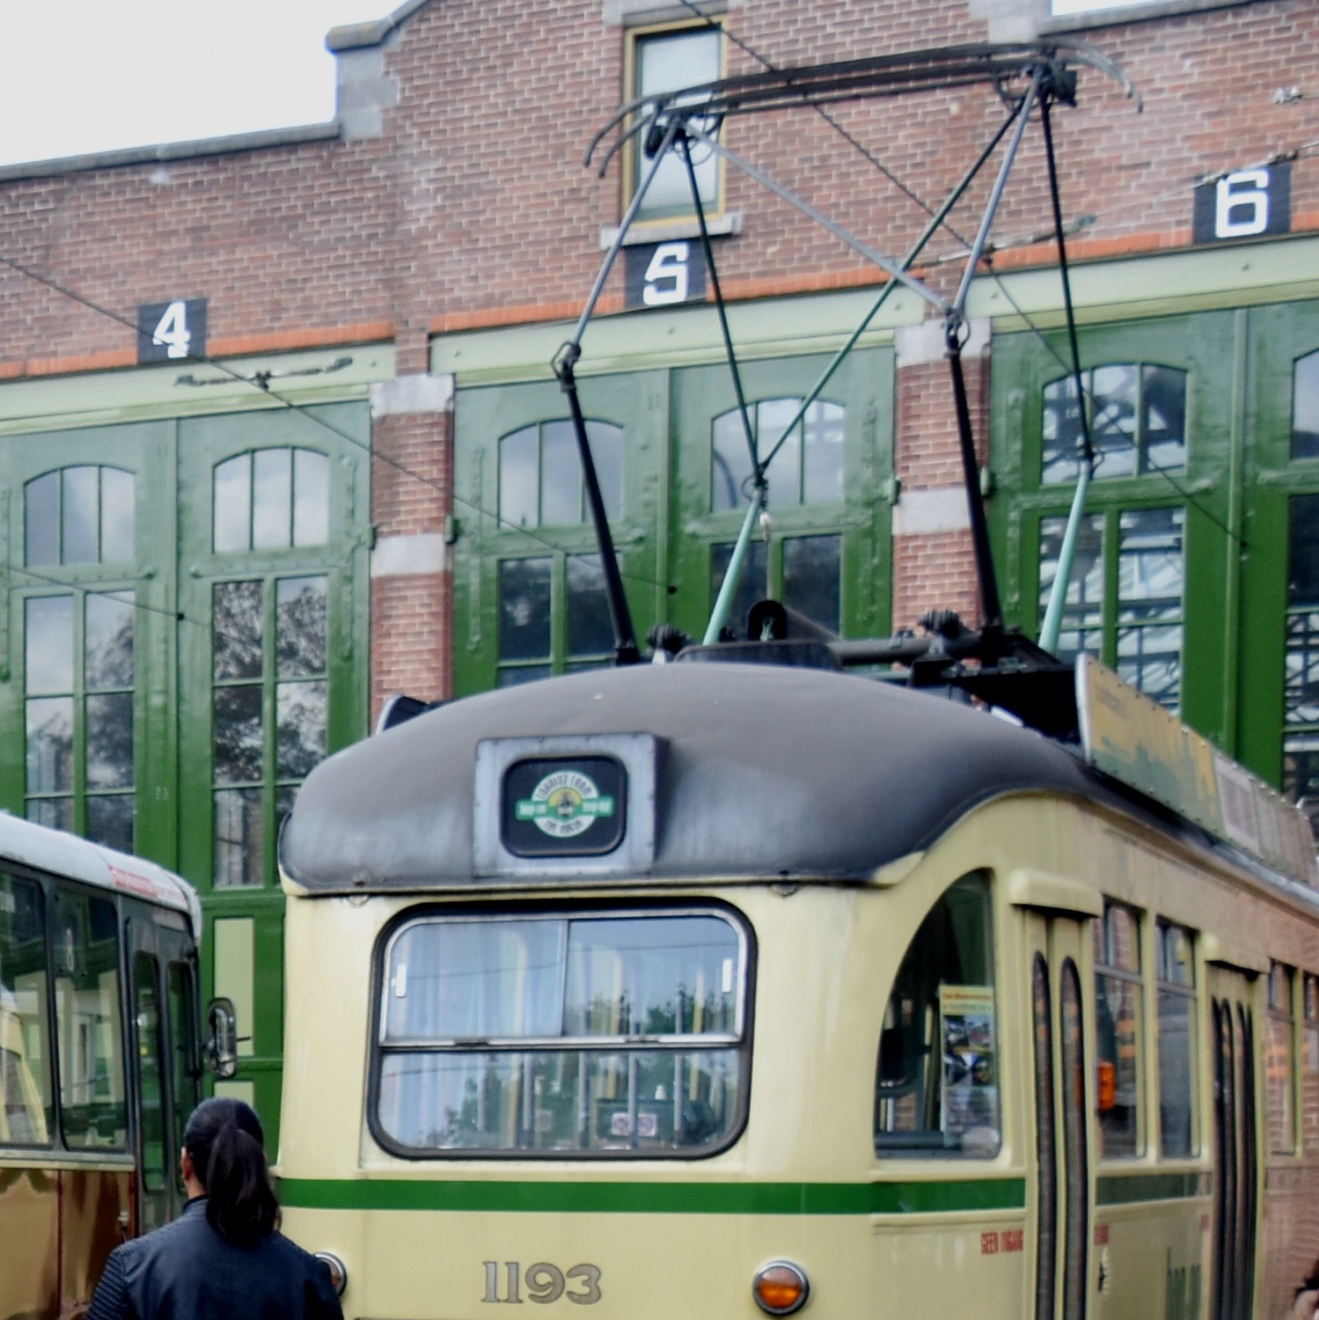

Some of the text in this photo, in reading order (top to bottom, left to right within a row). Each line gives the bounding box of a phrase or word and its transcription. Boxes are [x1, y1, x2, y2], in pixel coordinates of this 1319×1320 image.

[1215, 169, 1269, 238] 6
[643, 241, 689, 306] 5
[152, 301, 191, 358] 4
[481, 1261, 603, 1305] 1193
